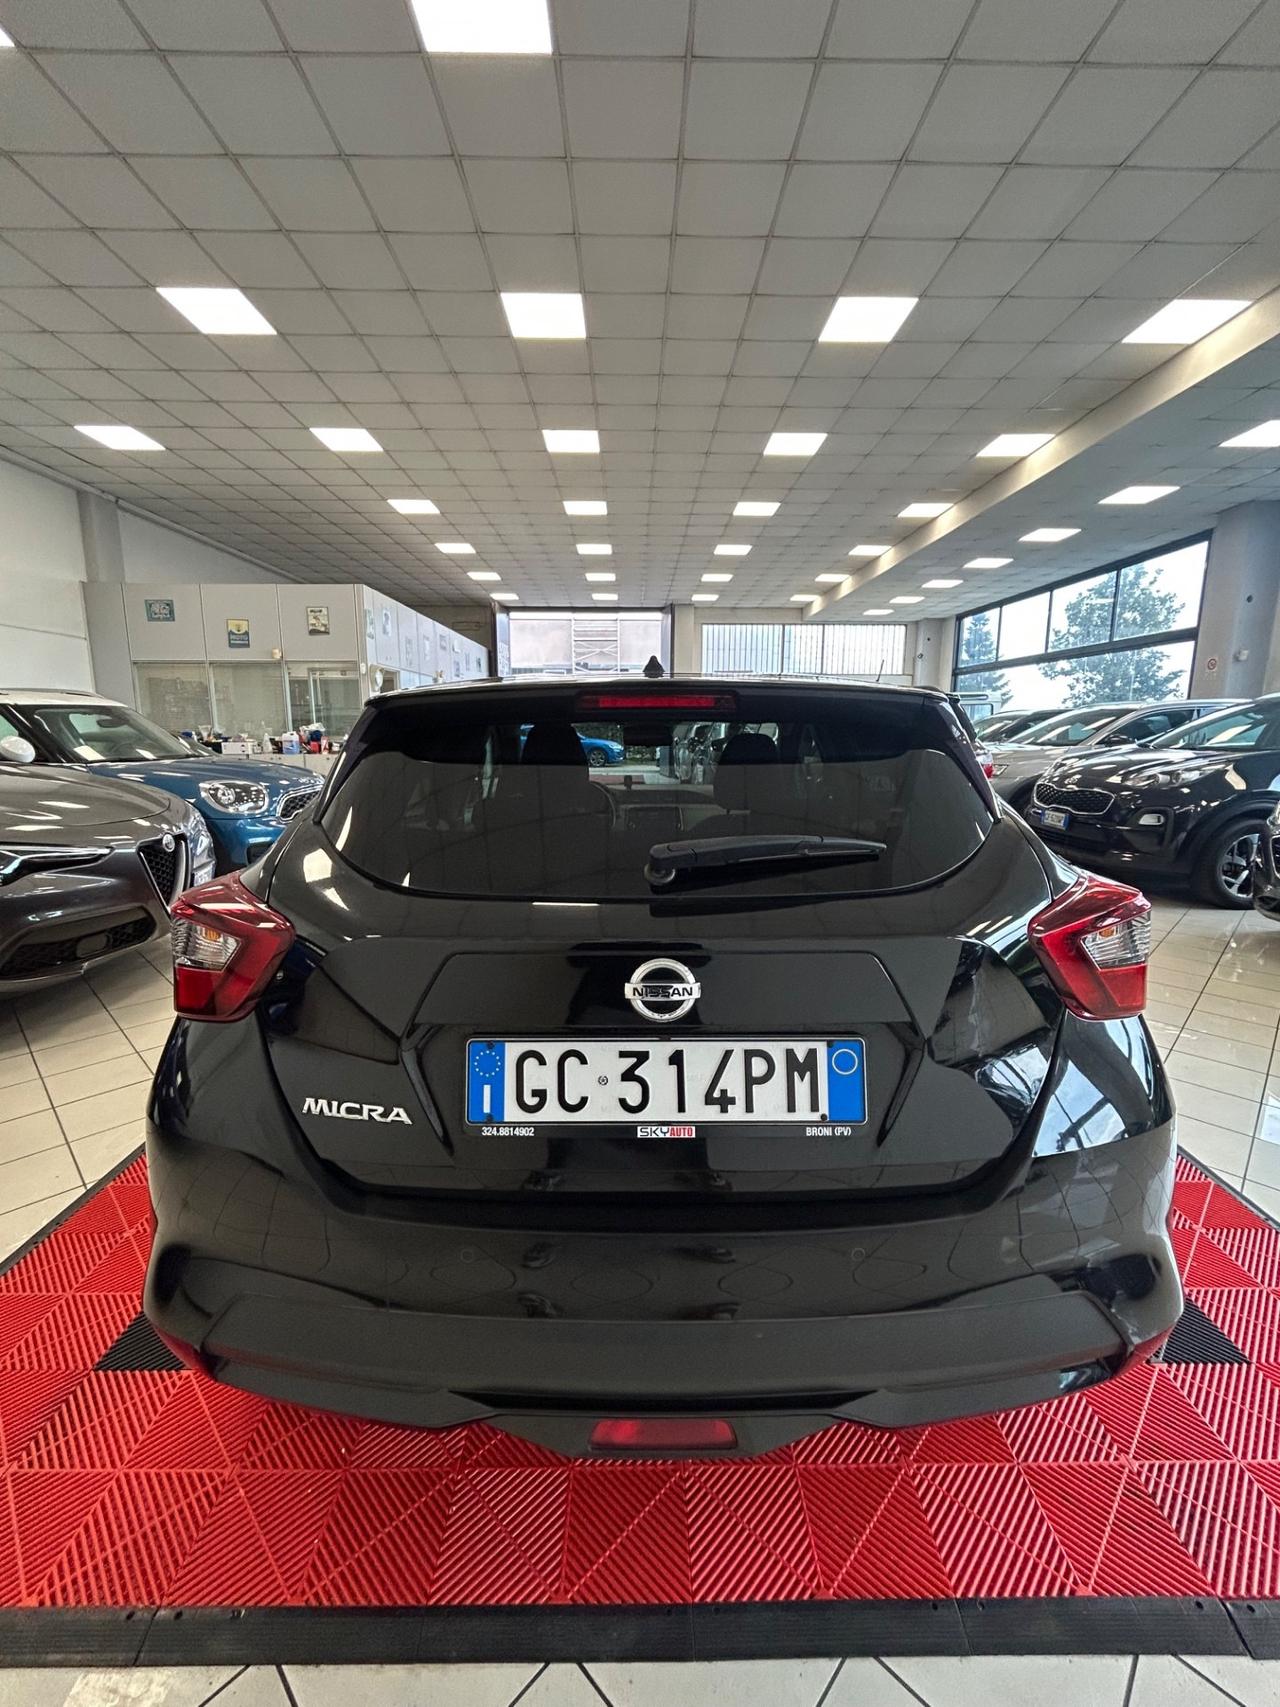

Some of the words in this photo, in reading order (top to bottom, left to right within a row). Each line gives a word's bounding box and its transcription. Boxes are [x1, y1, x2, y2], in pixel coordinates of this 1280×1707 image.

[632, 985, 693, 998] NISSAN
[302, 1098, 412, 1125] MICRA
[481, 1126, 535, 1137] 324.8814902
[805, 1126, 833, 1137] BRONI
[834, 1126, 852, 1137] (PV)
